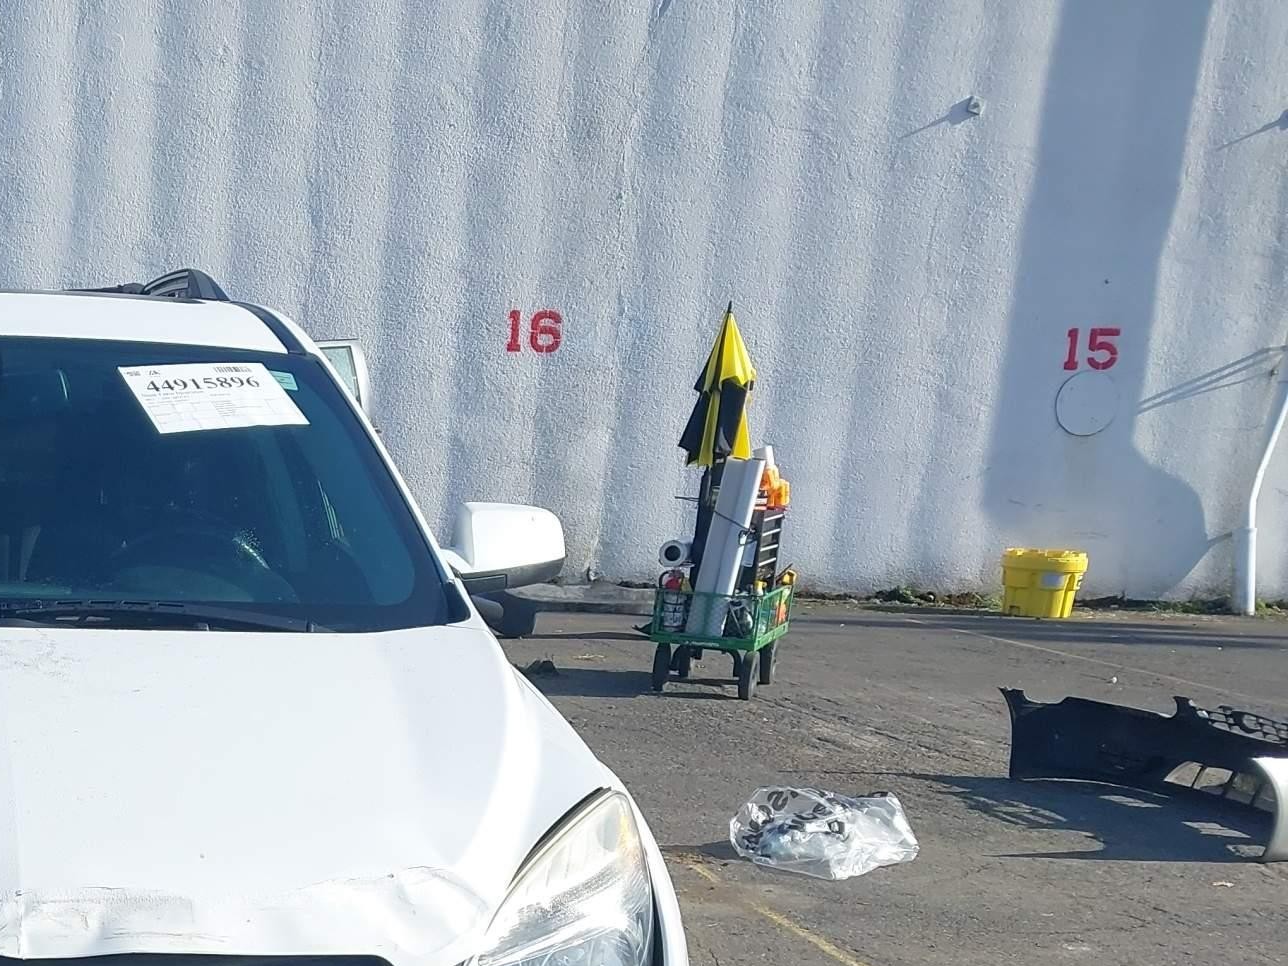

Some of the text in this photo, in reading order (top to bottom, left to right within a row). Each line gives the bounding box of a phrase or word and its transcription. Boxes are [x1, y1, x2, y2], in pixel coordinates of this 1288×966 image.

[506, 310, 561, 353] 16
[1063, 327, 1120, 370] 15
[146, 376, 260, 392] 44915896
